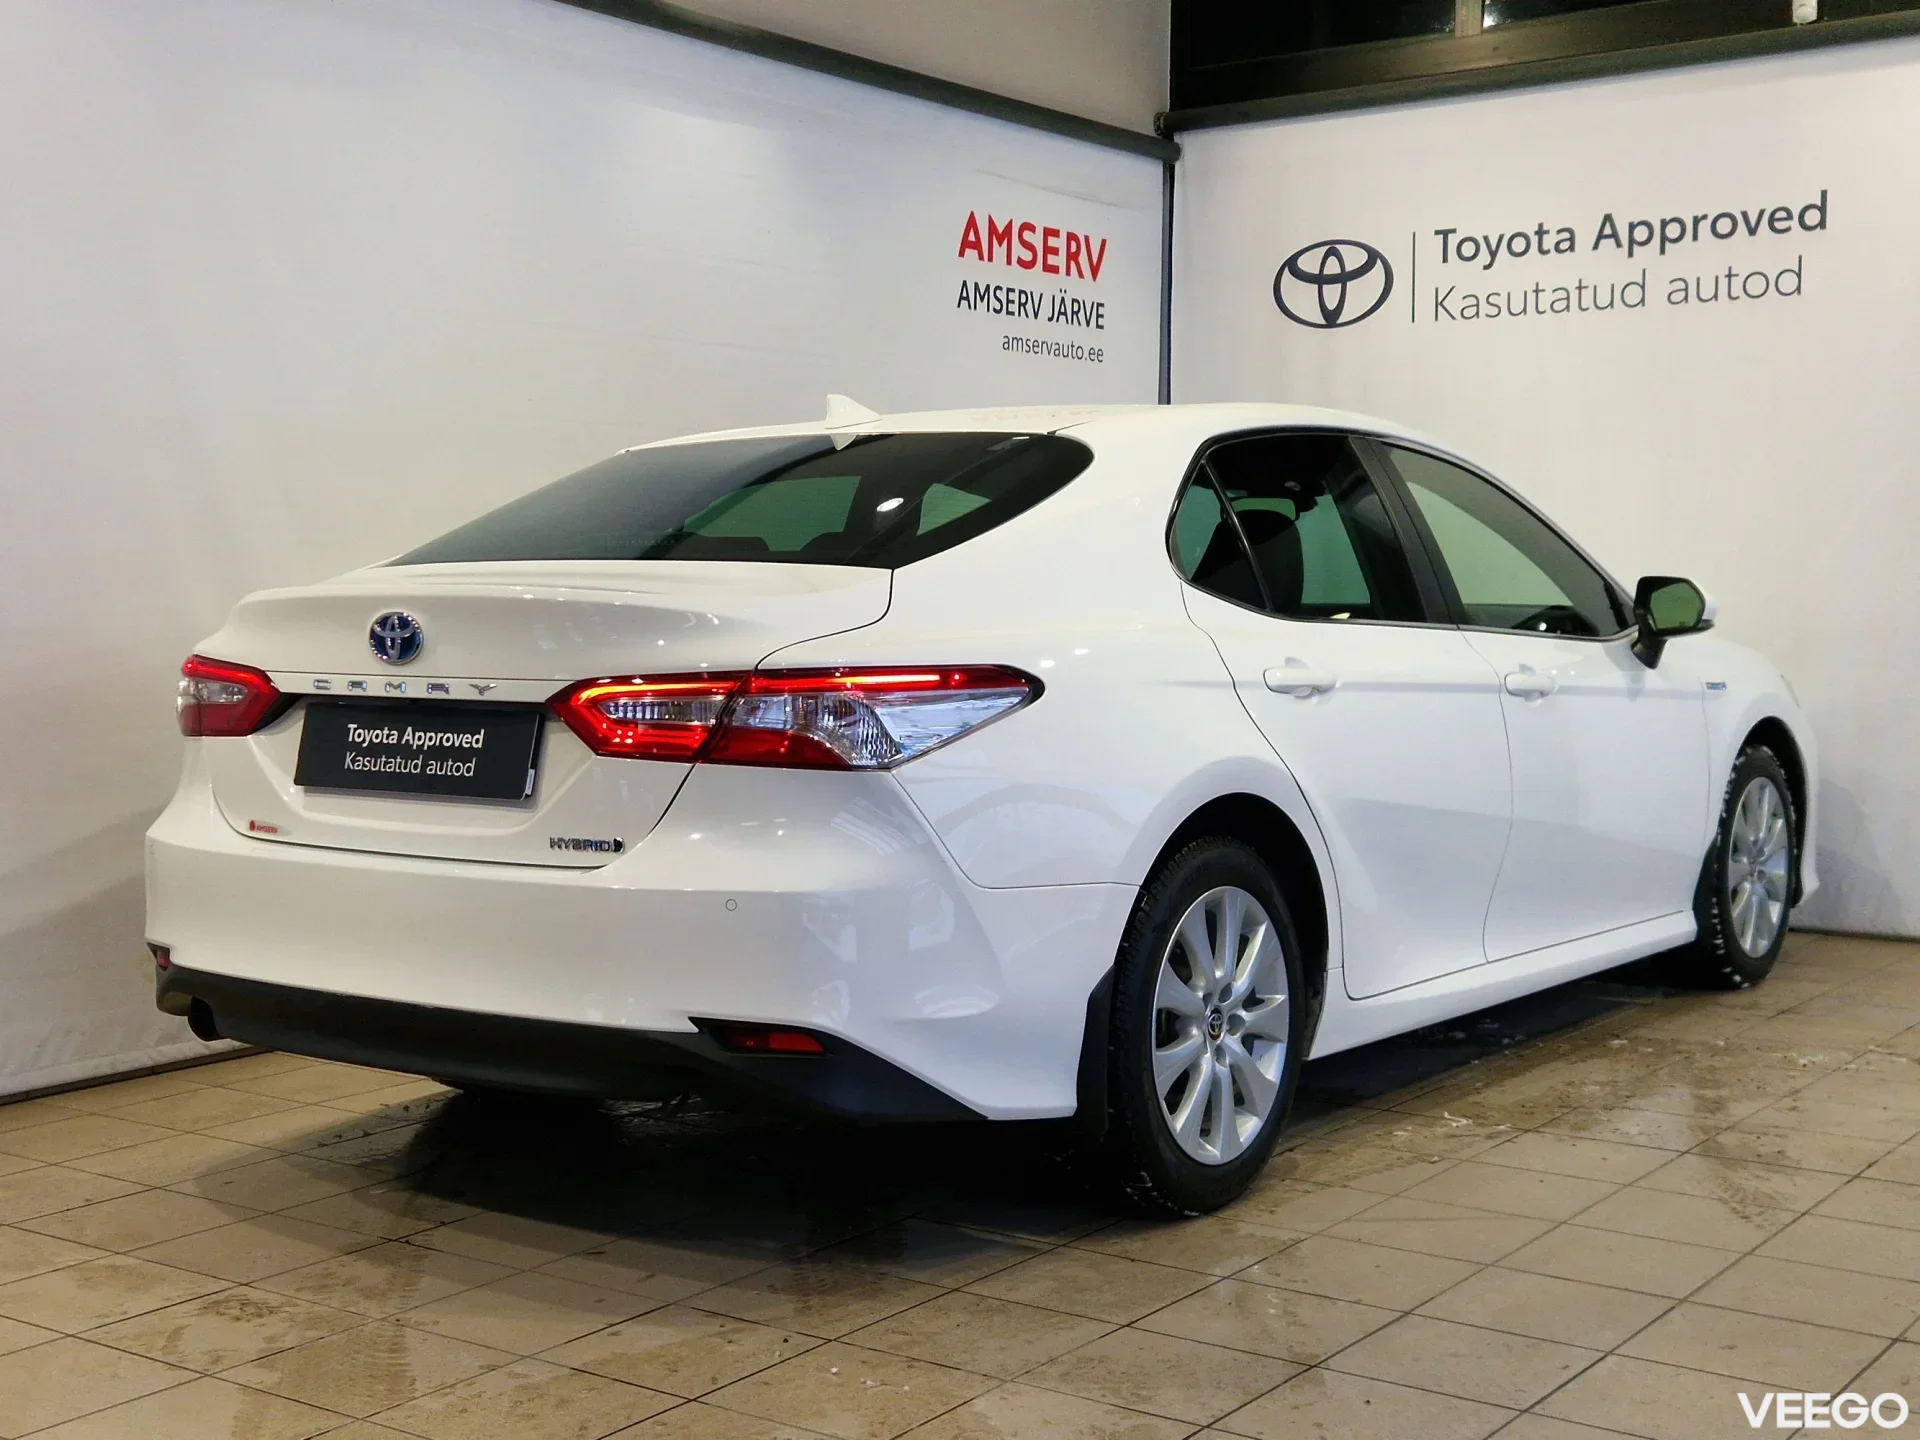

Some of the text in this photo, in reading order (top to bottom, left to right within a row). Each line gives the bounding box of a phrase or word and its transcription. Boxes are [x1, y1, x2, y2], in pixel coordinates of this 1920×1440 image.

[1433, 189, 1829, 271] Toyota Approved
[958, 211, 1107, 282] AMSERV
[1433, 254, 1804, 322] Kasutatud autod
[957, 280, 1105, 330] AMSERV JÄRVE
[1002, 334, 1104, 363] amservauto.ee
[313, 678, 498, 696] CAMRY
[346, 723, 485, 750] Toyota Approved
[344, 751, 476, 777] Kasutatud autod
[549, 836, 611, 852] HYBRID
